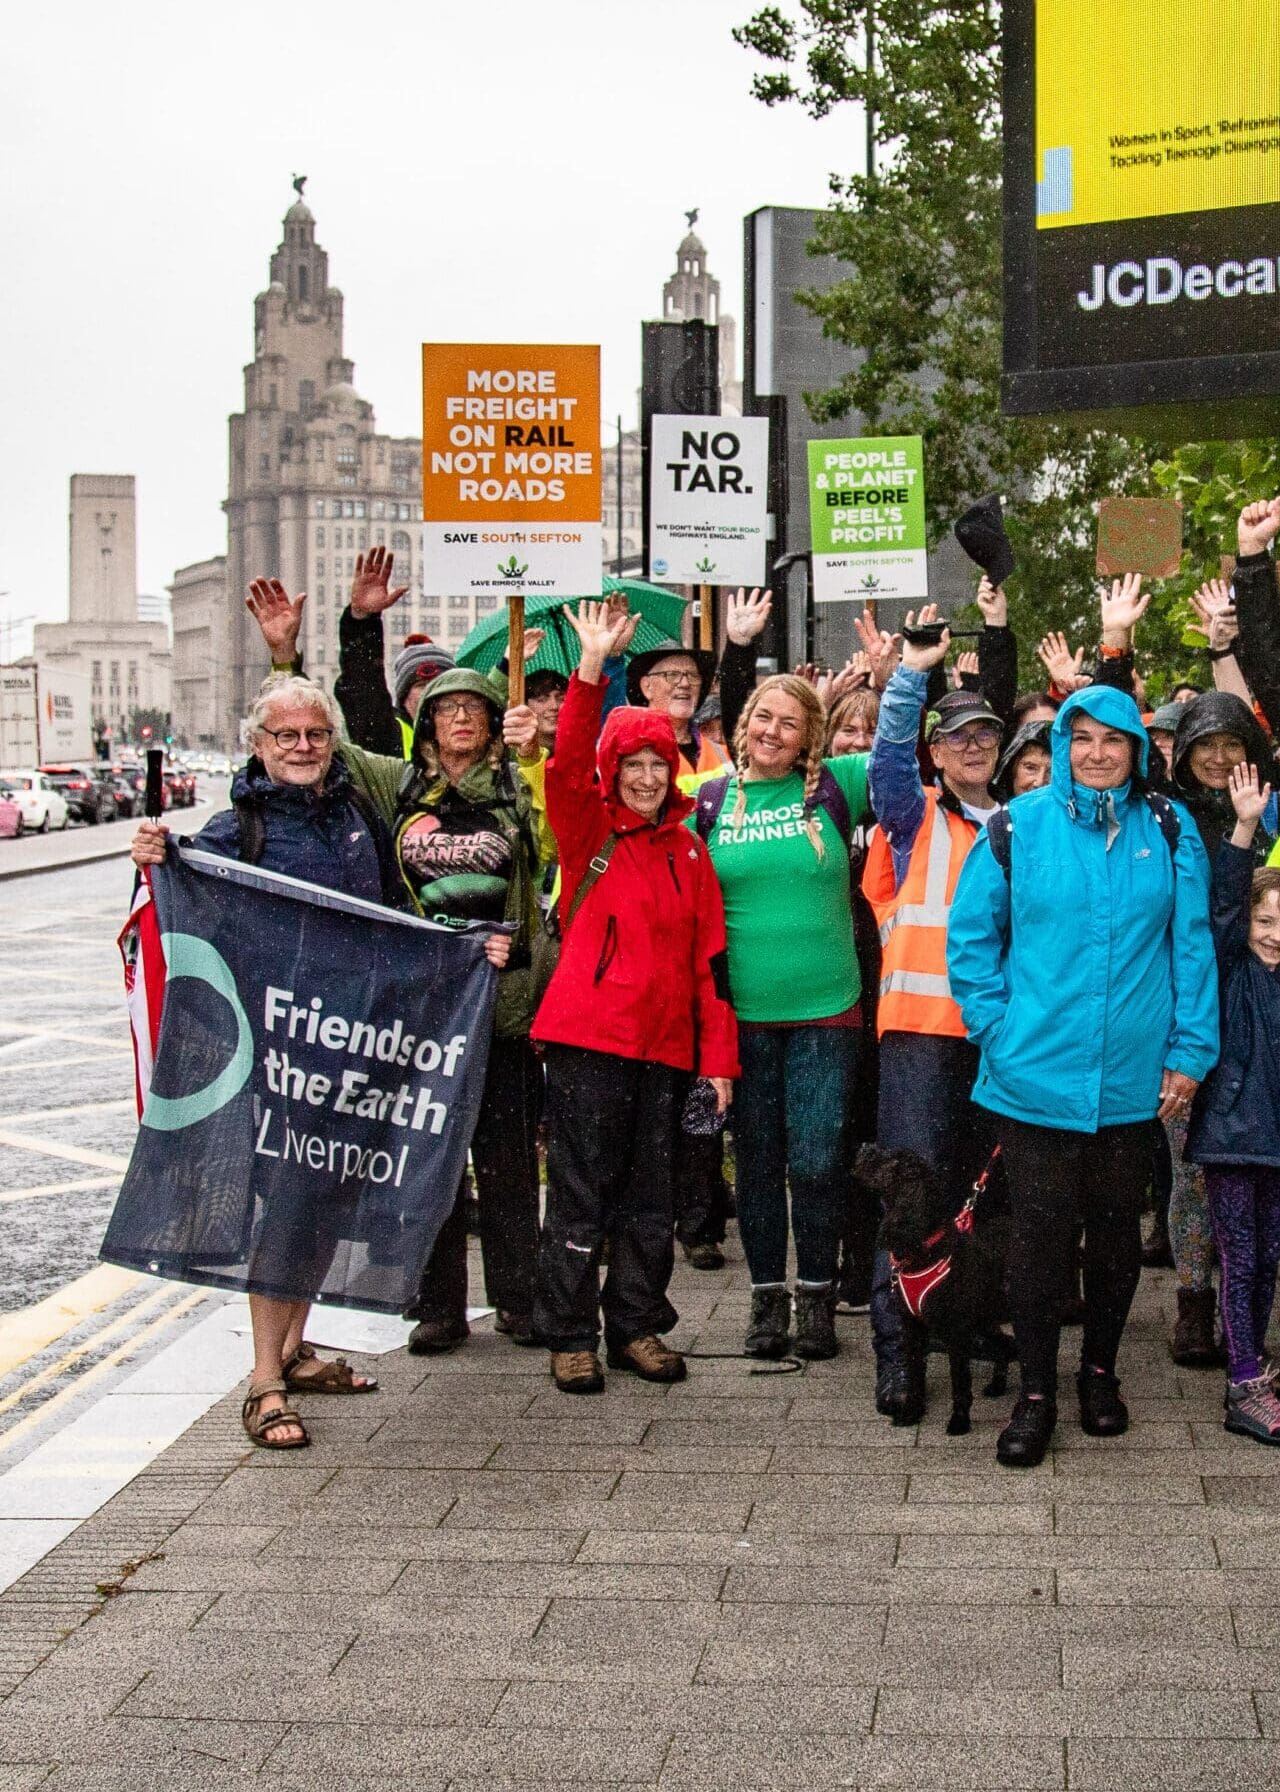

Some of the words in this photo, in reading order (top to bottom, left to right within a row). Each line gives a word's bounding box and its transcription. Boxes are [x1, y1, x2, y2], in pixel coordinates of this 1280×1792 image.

[1109, 133, 1157, 149] Women
[1160, 130, 1172, 142] in
[1110, 152, 1162, 169] Tackling
[1166, 145, 1221, 161] Teenage
[467, 370, 556, 393] MORE
[446, 397, 577, 420] FREIGHT
[450, 425, 495, 447] ON
[505, 426, 574, 447] RAIL
[682, 431, 741, 461] NO
[431, 452, 496, 474] NOT
[505, 452, 593, 475] MORE
[825, 451, 907, 470] PEOPLE
[666, 463, 753, 494] TAR.
[815, 472, 830, 489] &
[834, 469, 918, 488] PLANET
[459, 479, 566, 502] ROADS
[826, 488, 909, 507] BEFORE
[833, 507, 903, 525] PEEL'S
[444, 533, 478, 543] SAVE
[482, 533, 526, 543] SOUTH
[531, 534, 581, 543] SEFTON
[831, 525, 907, 544] PROFIT
[826, 560, 848, 568] SAVE
[849, 558, 879, 567] SOUTH
[880, 556, 913, 565] SEFTON
[721, 802, 812, 826] RMROS
[718, 817, 823, 846] RUNNERS
[402, 846, 478, 861] PLANET
[264, 1048, 332, 1106] the
[333, 1069, 448, 1135] Earth
[255, 1108, 409, 1187] Liverpool
